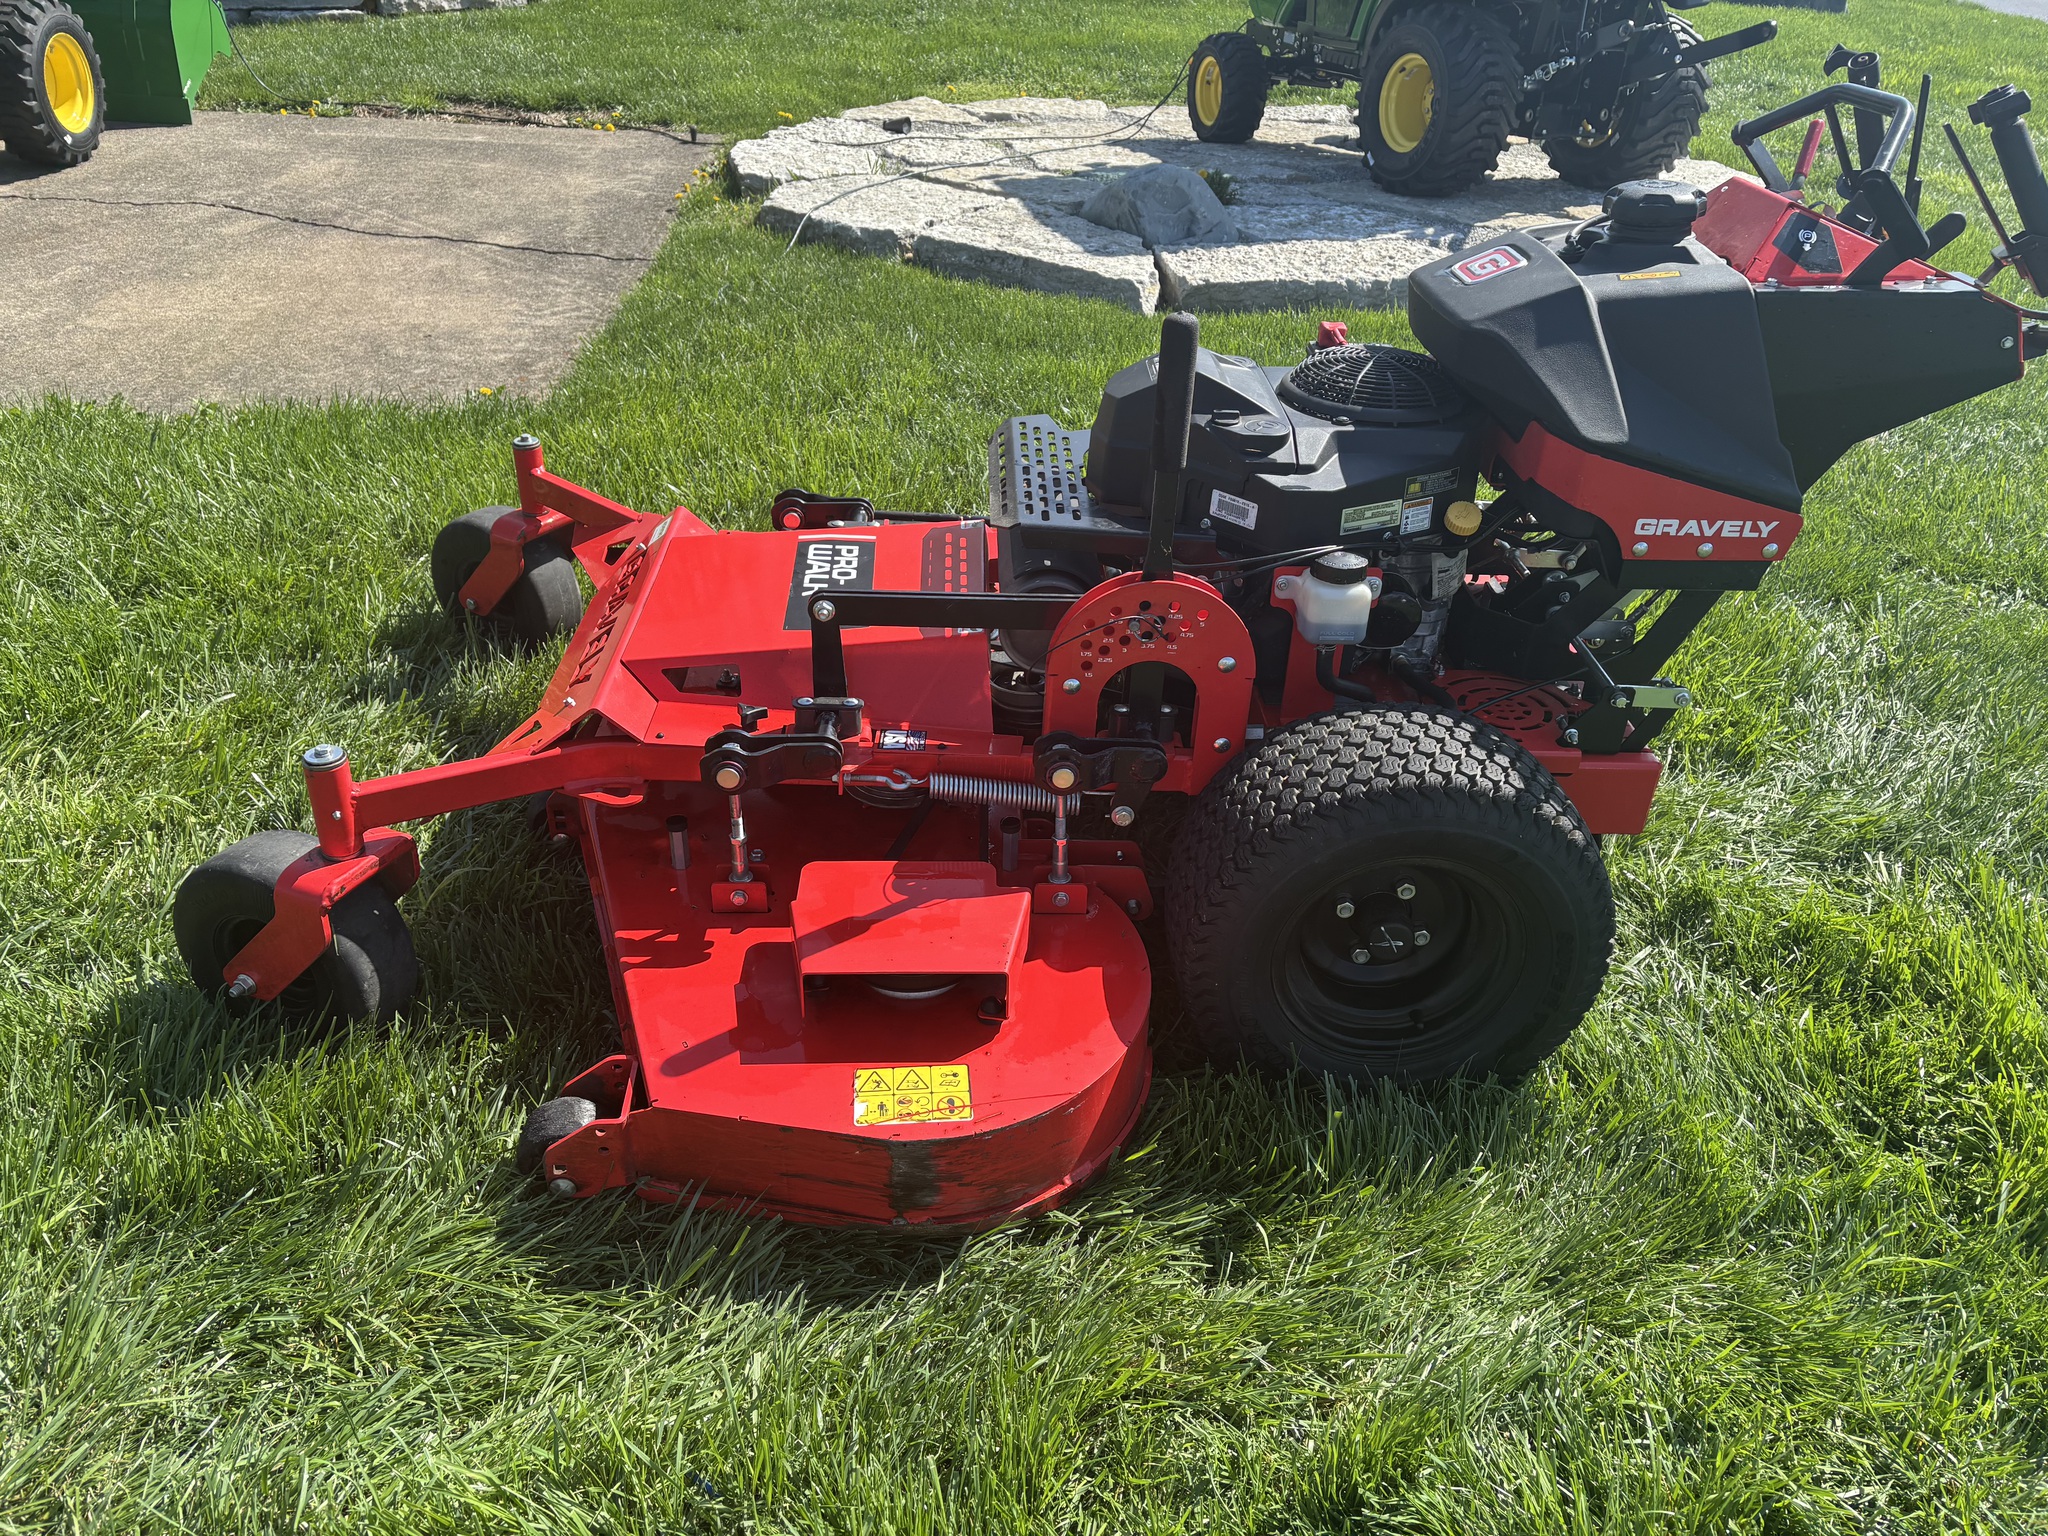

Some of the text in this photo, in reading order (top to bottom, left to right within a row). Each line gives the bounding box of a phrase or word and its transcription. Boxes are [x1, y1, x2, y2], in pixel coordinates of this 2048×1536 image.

[1634, 518, 1780, 538] GRAVELY
[801, 544, 833, 596] WALK
[832, 545, 859, 585] PRO-
[883, 730, 908, 749] USA
